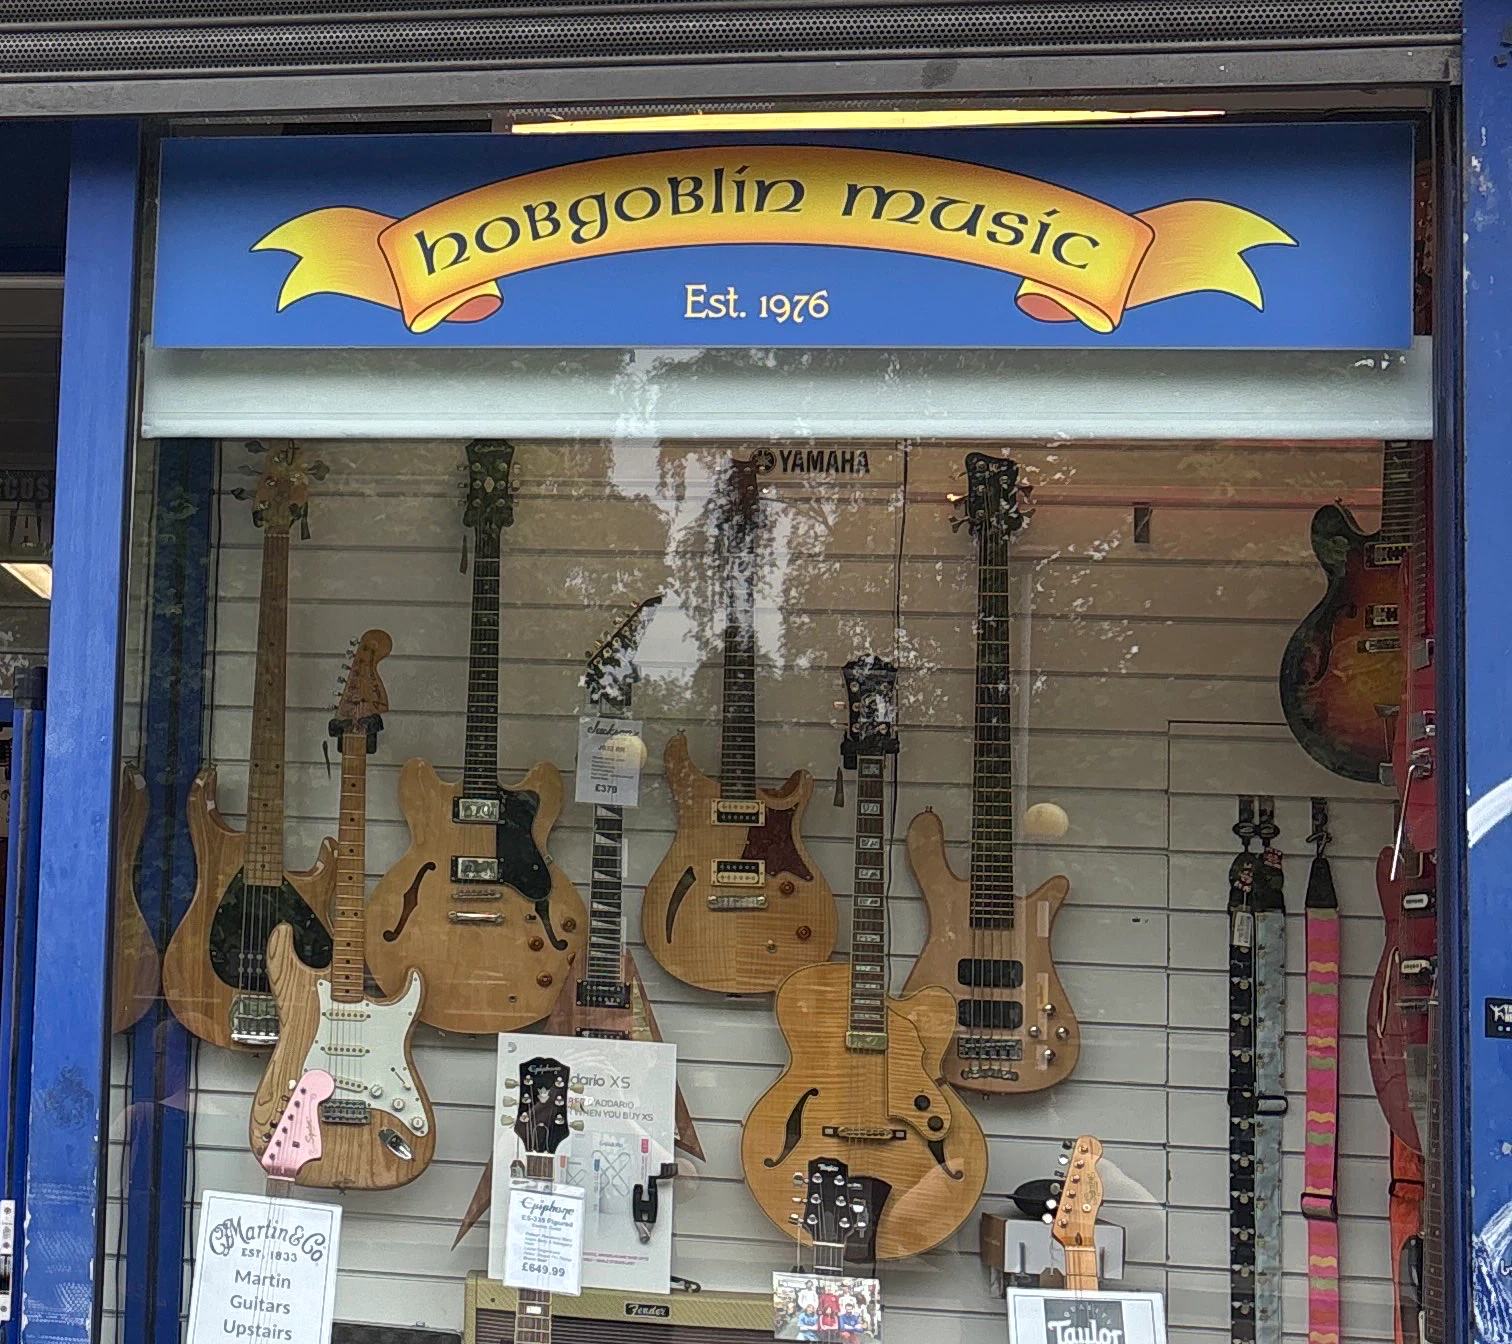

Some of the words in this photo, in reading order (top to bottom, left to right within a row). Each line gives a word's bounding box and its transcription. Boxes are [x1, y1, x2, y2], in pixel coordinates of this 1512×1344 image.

[685, 284, 747, 322] Est.
[758, 288, 831, 326] 1976
[779, 450, 870, 473] YAMAHA
[610, 1075, 631, 1089] XS
[270, 1251, 298, 1263] 1833
[235, 1269, 292, 1290] Martin
[521, 1262, 566, 1277] £649.99
[230, 1294, 291, 1315] Guitars
[223, 1318, 293, 1341] Upstairs
